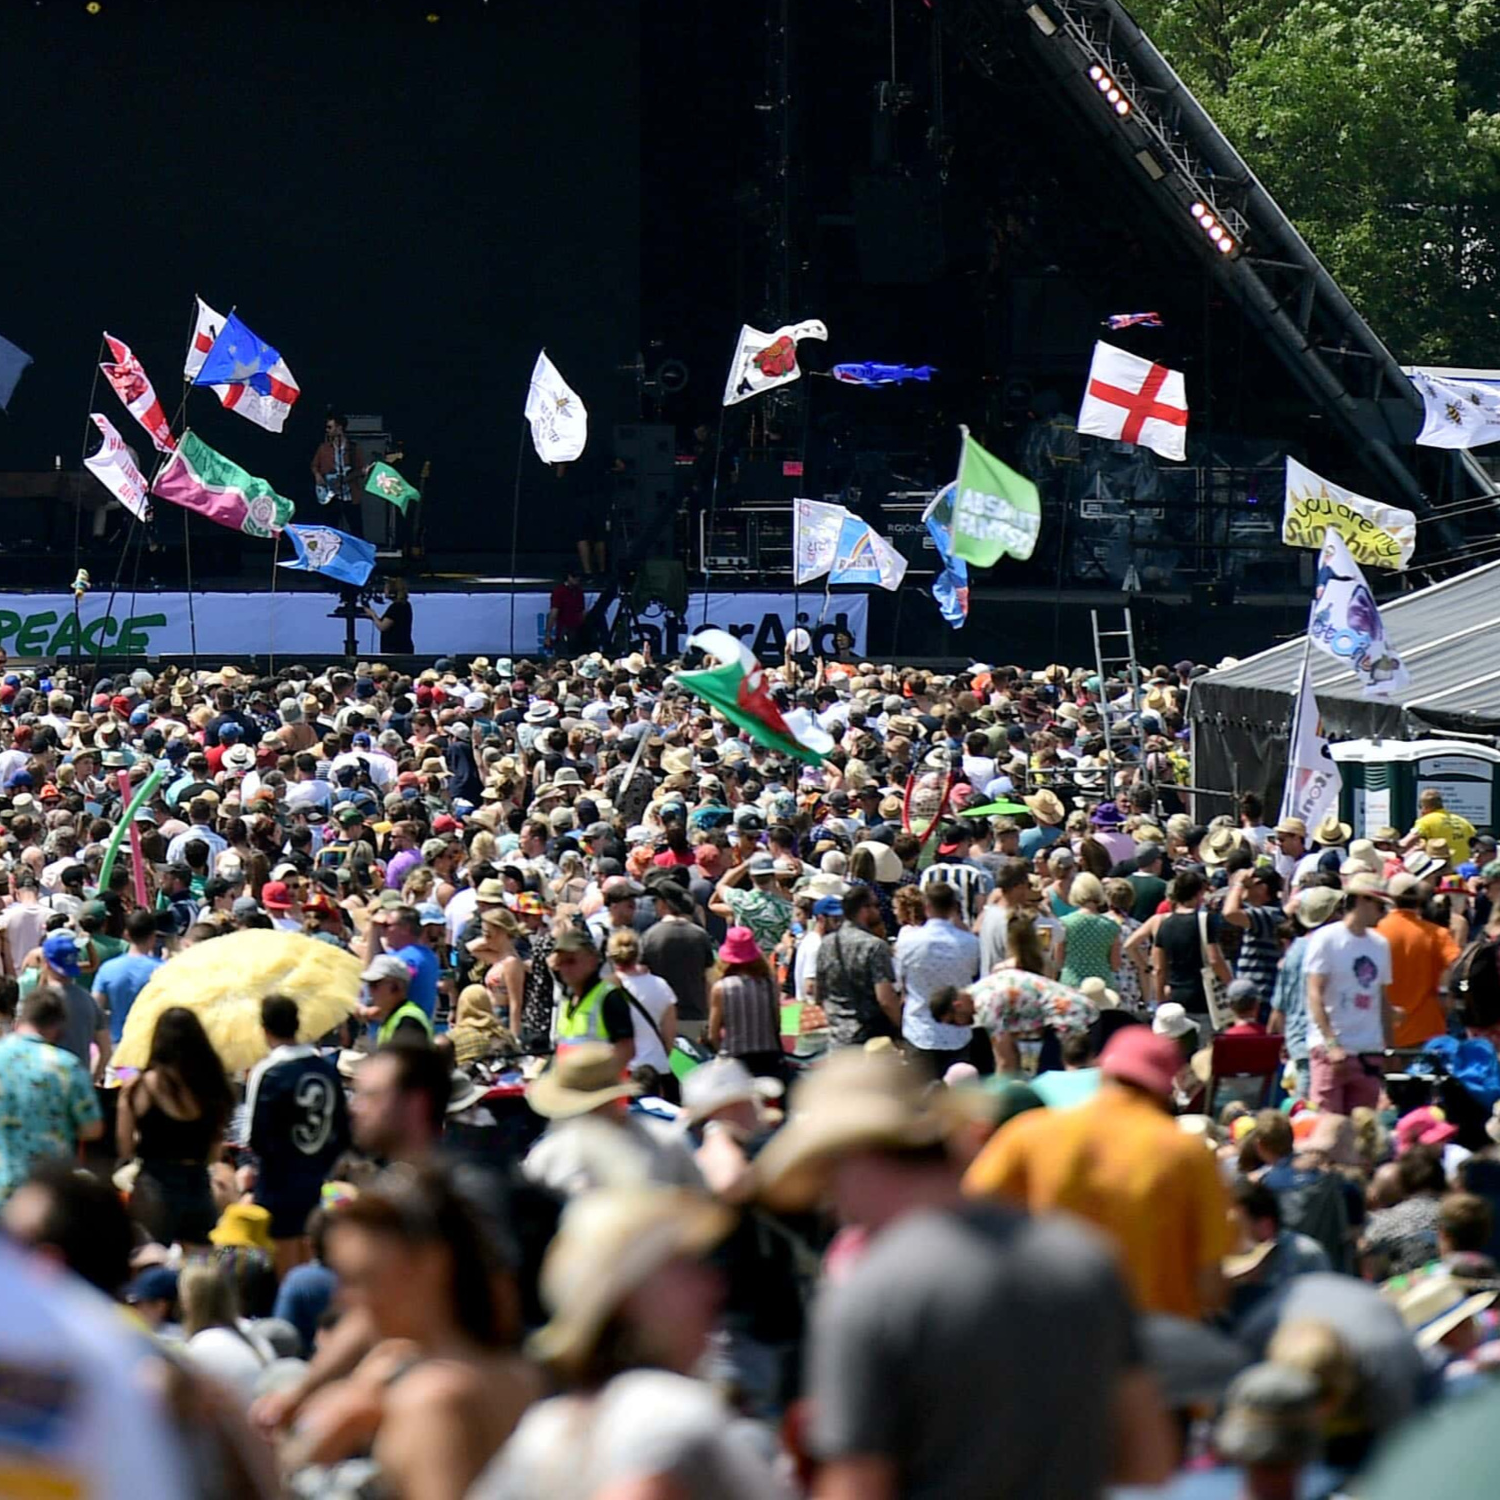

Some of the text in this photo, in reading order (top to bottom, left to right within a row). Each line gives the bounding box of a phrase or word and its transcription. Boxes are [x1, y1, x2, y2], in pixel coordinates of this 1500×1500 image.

[1295, 498, 1402, 557] you are my
[293, 1071, 336, 1155] 3
